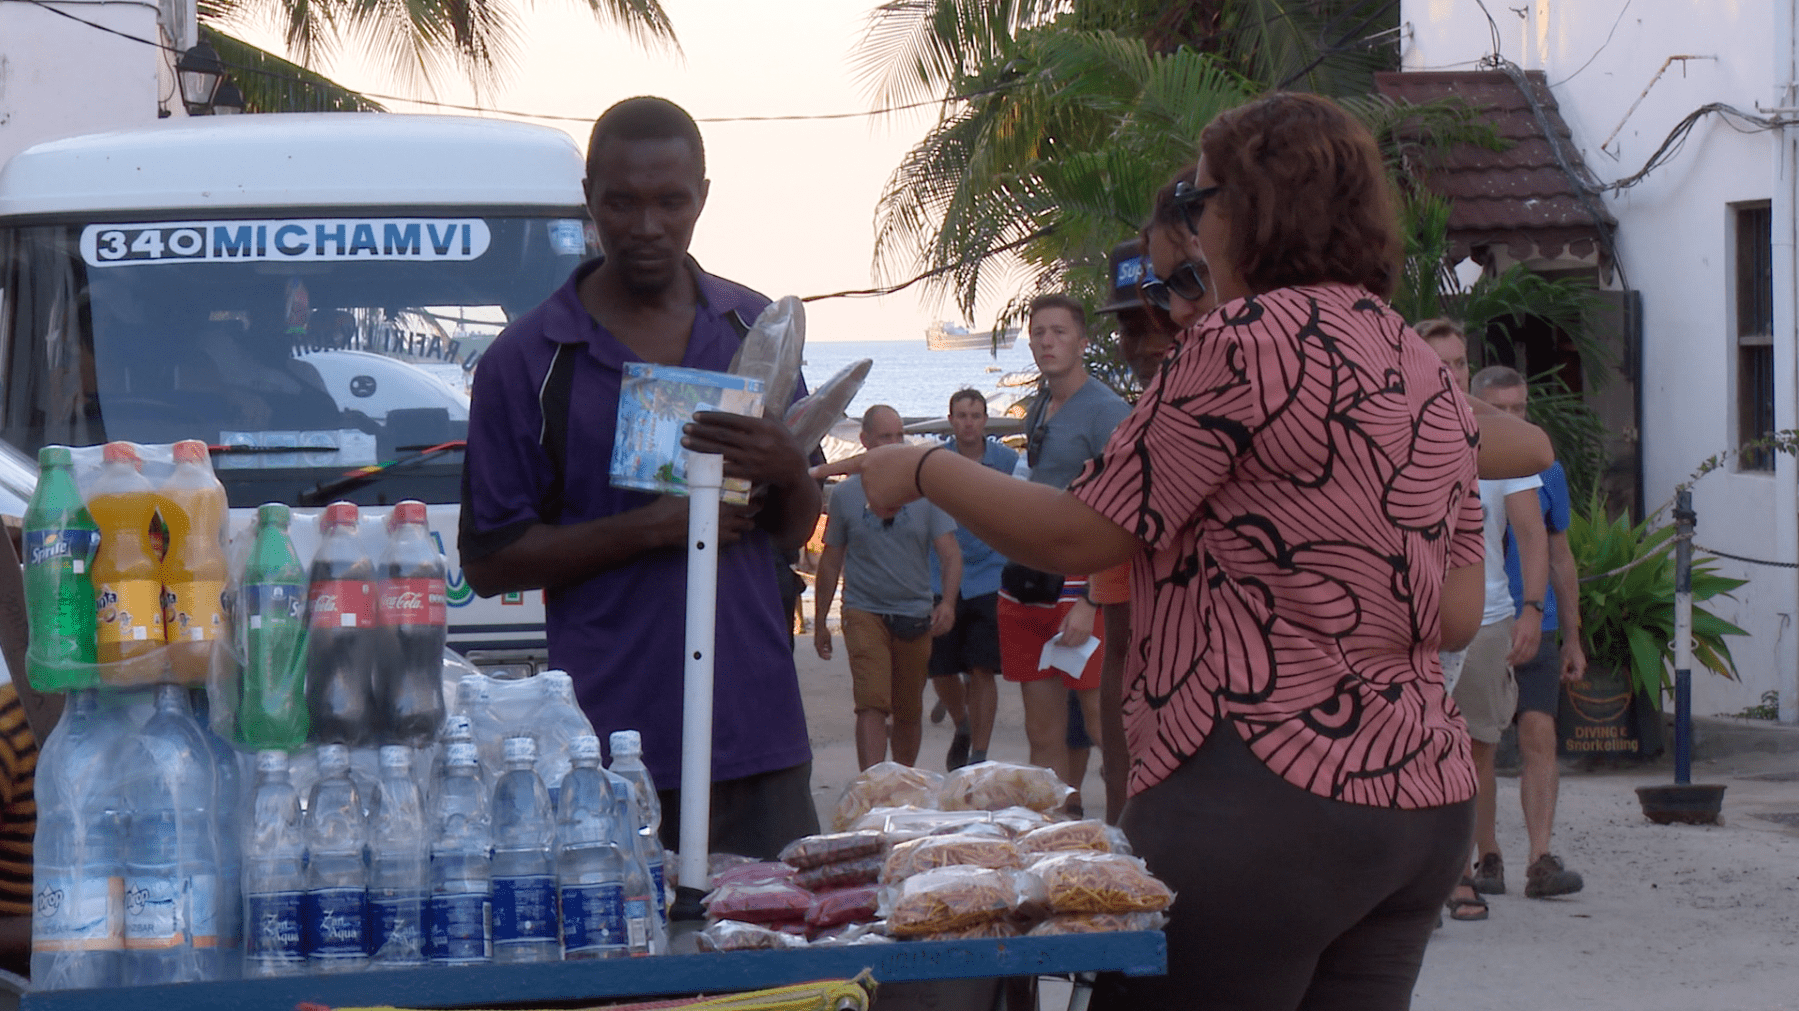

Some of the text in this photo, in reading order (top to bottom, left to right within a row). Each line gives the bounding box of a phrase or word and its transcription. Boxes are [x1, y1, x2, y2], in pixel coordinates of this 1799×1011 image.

[98, 223, 472, 259] 340 MICHAMVI
[32, 541, 68, 564] Sprite
[1575, 726, 1618, 738] DIVING
[320, 909, 345, 930] Zan
[329, 926, 358, 941] Aqua
